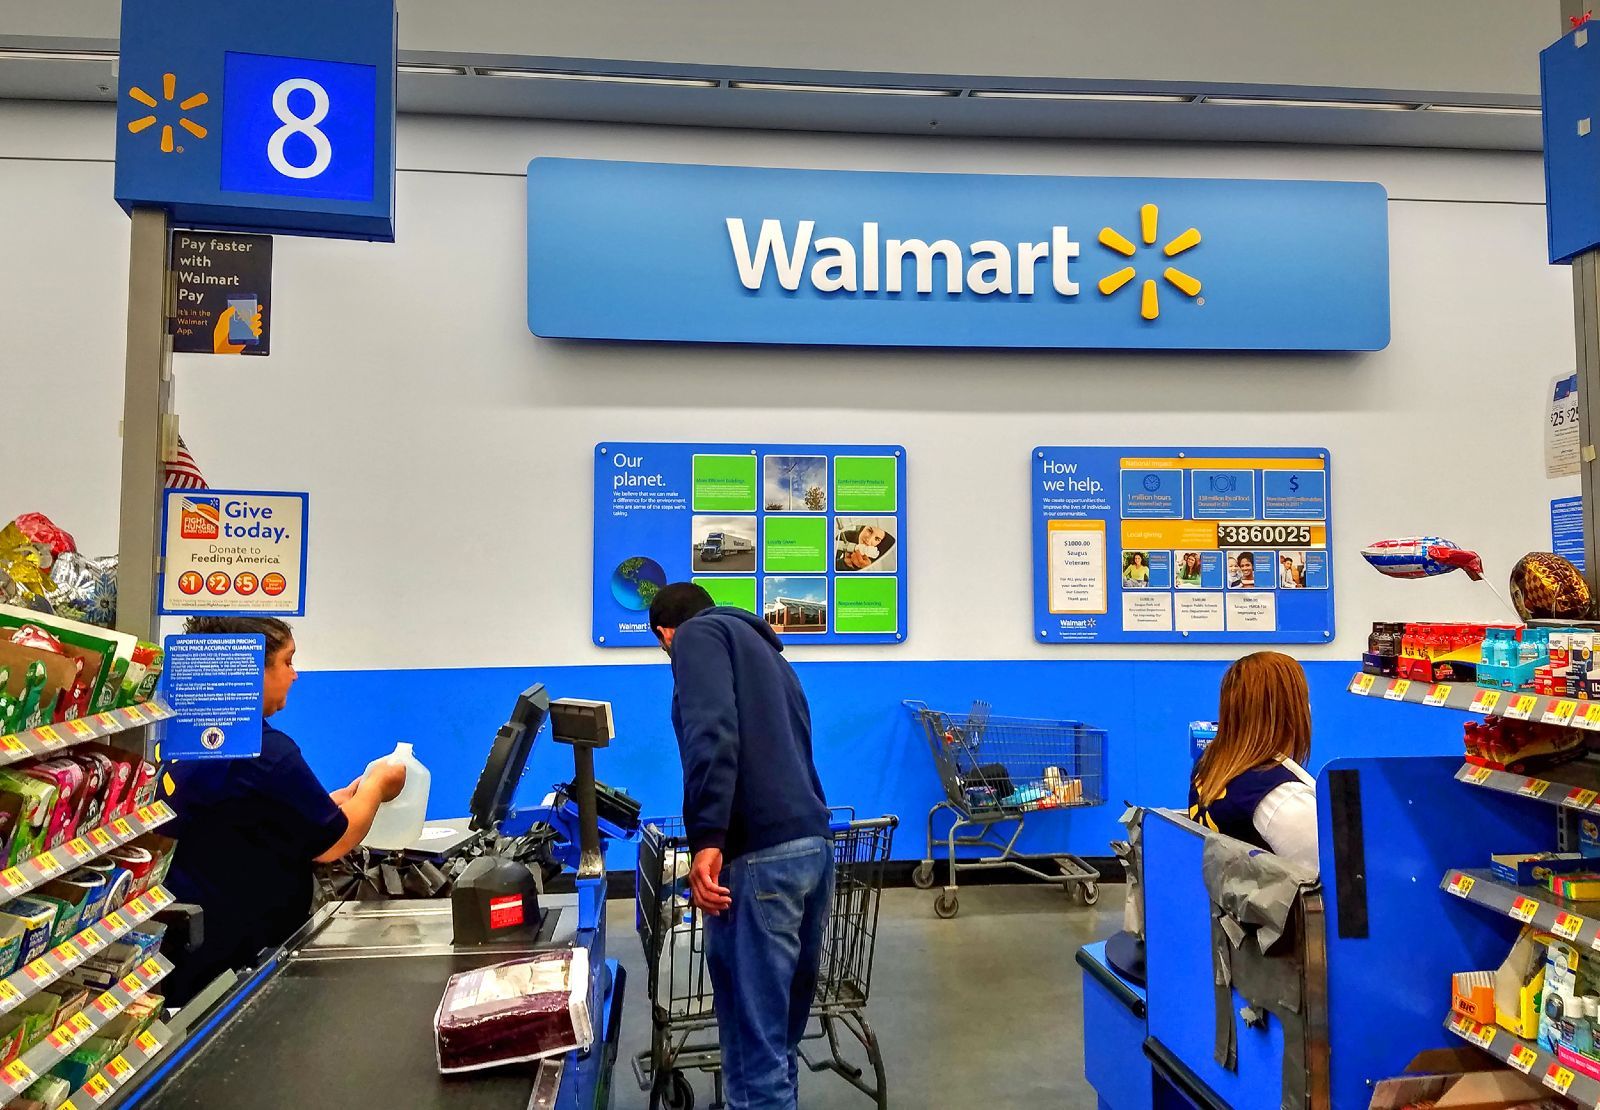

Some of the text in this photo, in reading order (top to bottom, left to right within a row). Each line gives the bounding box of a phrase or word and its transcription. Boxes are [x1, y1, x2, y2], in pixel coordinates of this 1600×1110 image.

[268, 78, 332, 179] 8
[181, 238, 252, 253] Pay faster
[180, 255, 211, 267] with
[726, 218, 1080, 296] Walmart
[179, 272, 239, 286] Walmart
[179, 289, 204, 304] Pay
[613, 454, 643, 468] Our
[1043, 460, 1078, 474] How
[613, 472, 666, 489] planet.
[1043, 477, 1104, 494] we help.
[225, 501, 272, 518] Give
[224, 522, 290, 543] today.
[1218, 526, 1310, 543] $3860025
[209, 545, 260, 554] Donate to
[192, 554, 232, 565] Feeding
[182, 576, 253, 591] $1 $2 $5
[1460, 1001, 1476, 1013] BIC
